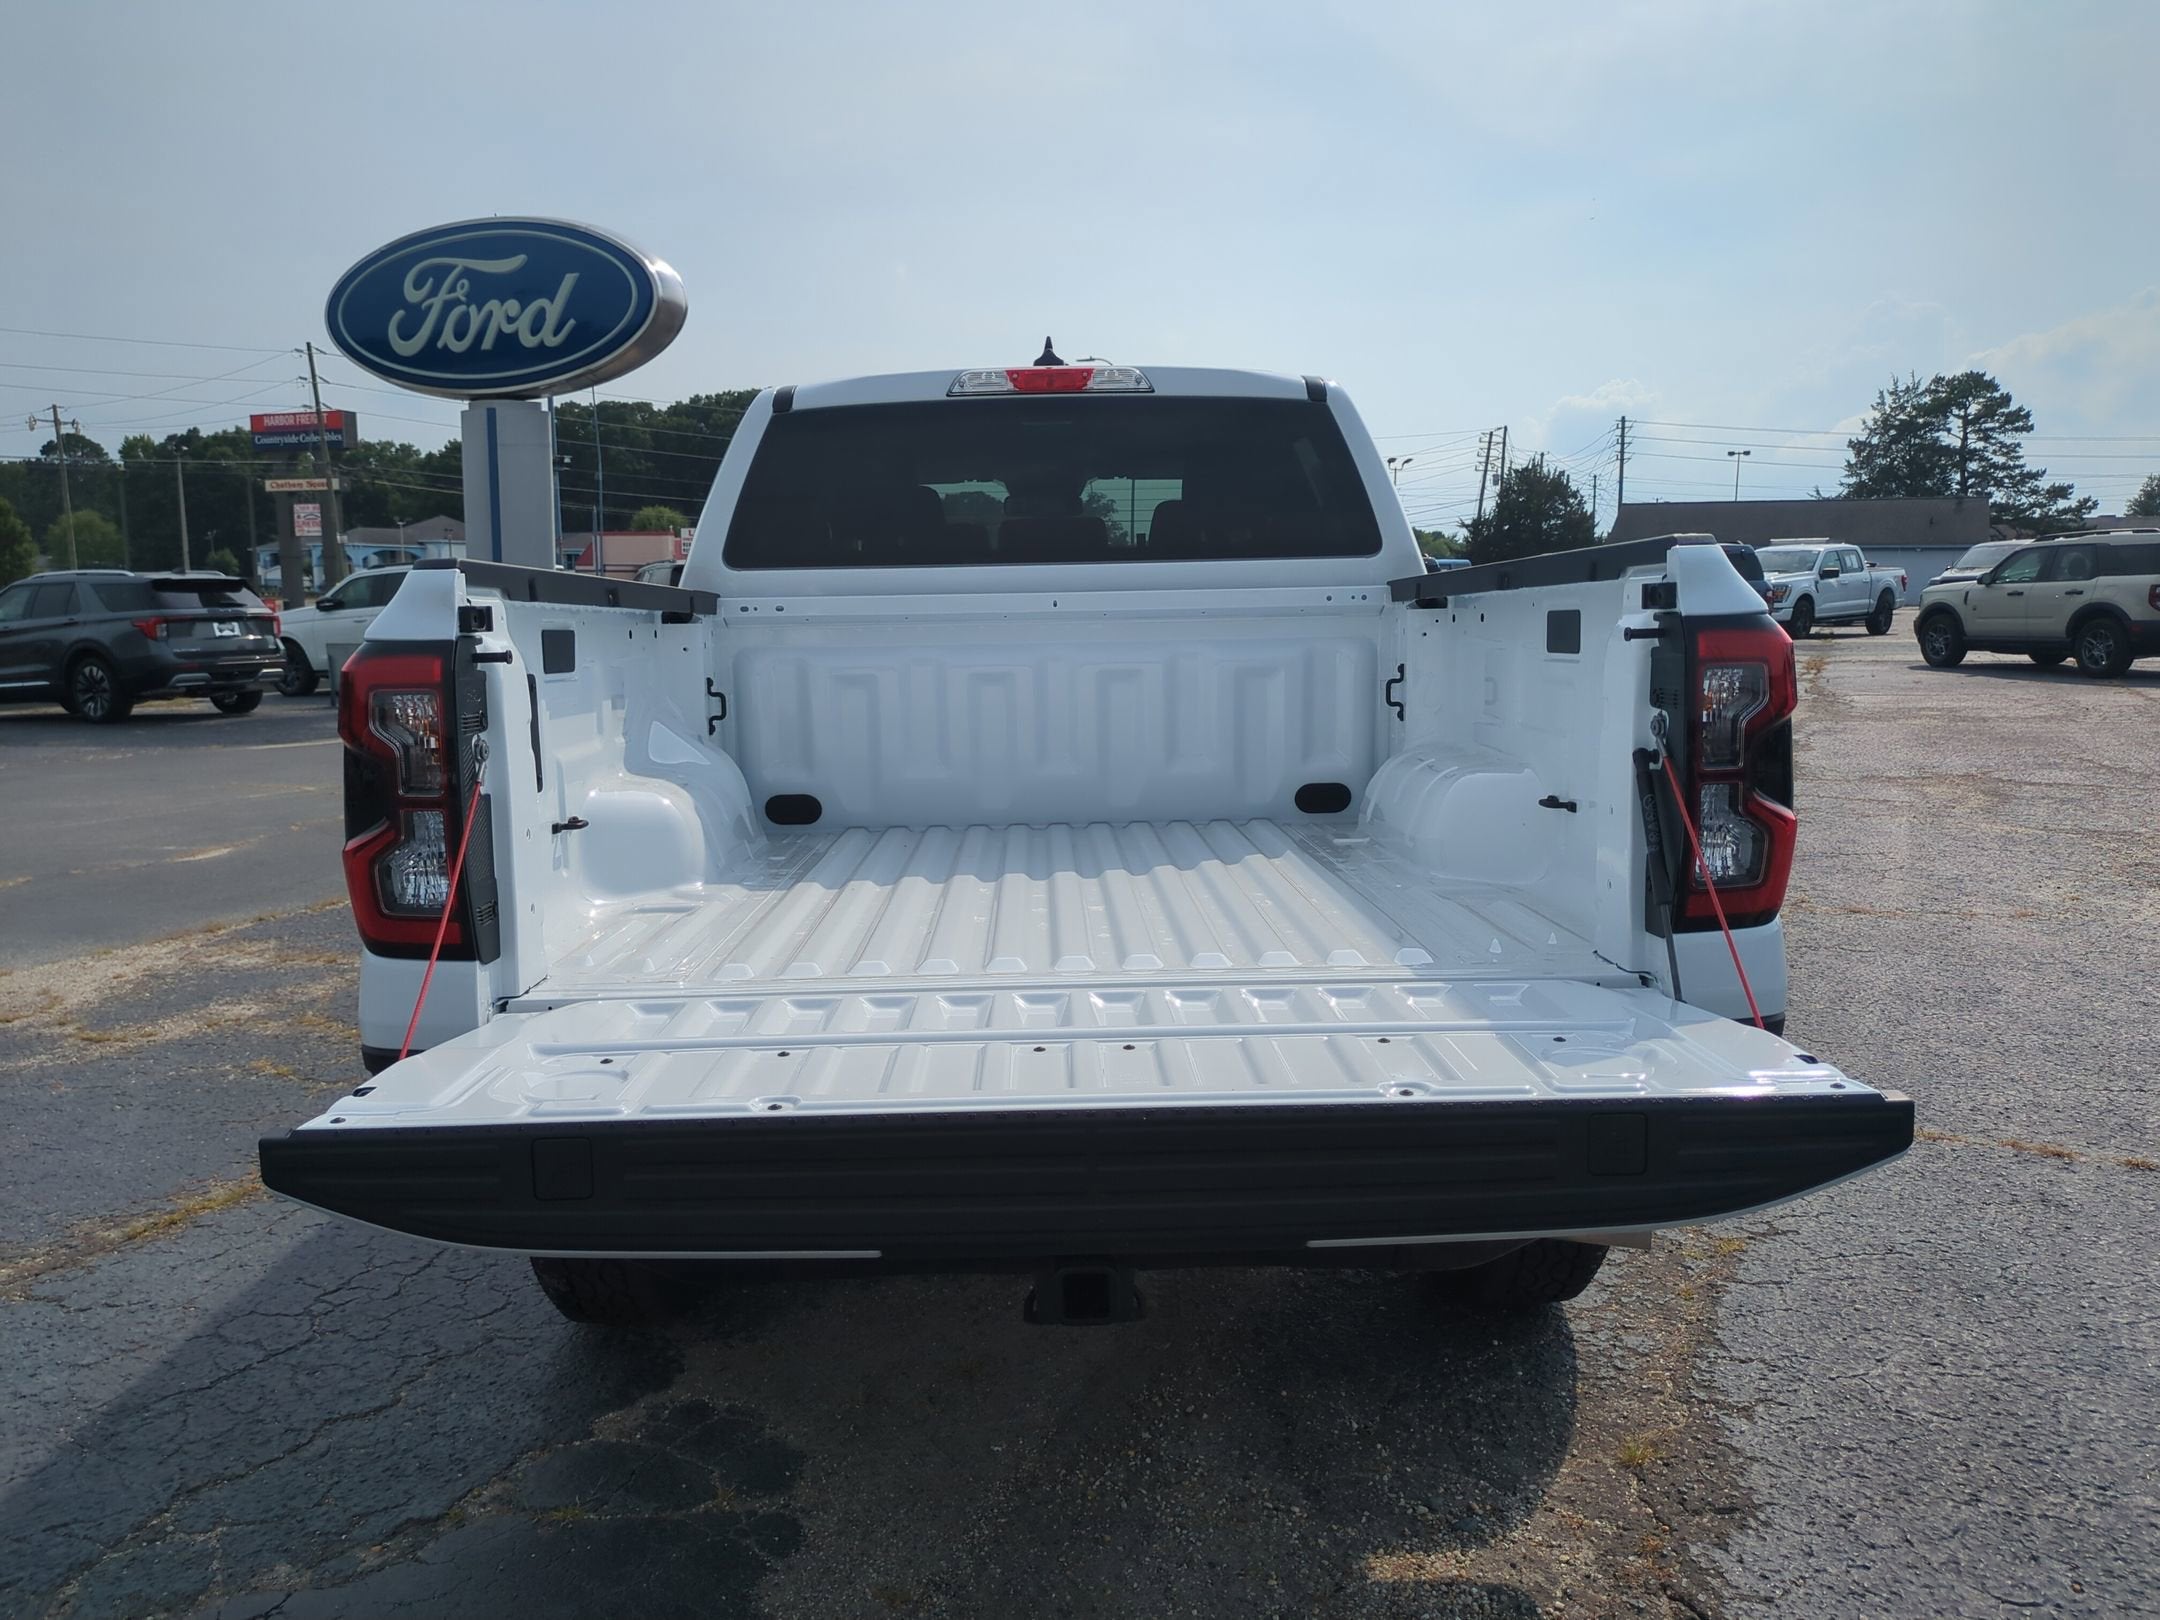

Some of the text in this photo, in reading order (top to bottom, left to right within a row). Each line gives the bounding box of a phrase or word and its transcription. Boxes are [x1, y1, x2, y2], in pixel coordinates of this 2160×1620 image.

[388, 254, 580, 356] Ford
[263, 412, 328, 426] HARBOR FREIGT
[255, 433, 299, 446] Countryside
